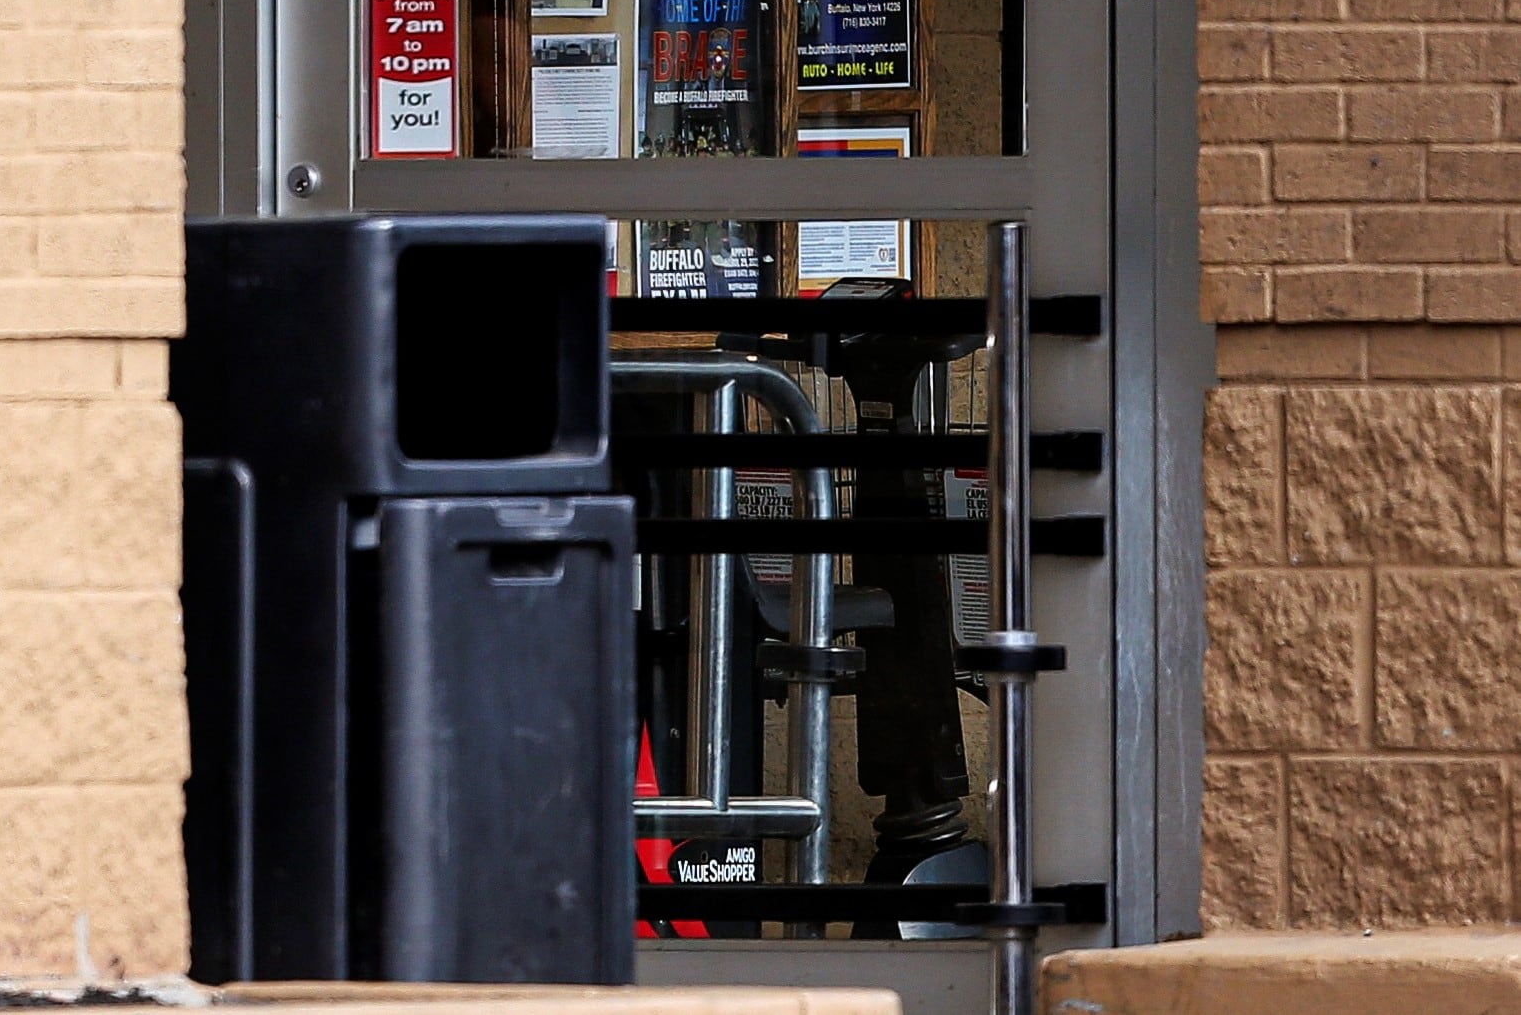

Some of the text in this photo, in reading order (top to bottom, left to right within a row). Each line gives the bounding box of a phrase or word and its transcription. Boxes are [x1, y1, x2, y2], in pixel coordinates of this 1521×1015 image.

[394, 0, 435, 12] from
[853, 4, 866, 13] New
[867, 2, 881, 13] York
[403, 39, 422, 52] to
[653, 29, 748, 82] BRAE
[803, 64, 828, 78] AUTO
[837, 62, 866, 76] HOME
[875, 61, 894, 75] LIFE
[399, 89, 431, 106] for
[654, 91, 678, 104] BECOME
[683, 90, 707, 102] BUFFALO
[391, 110, 439, 130] you!
[649, 248, 704, 271] BUFFALO
[649, 272, 706, 288] FIREFIGHTER
[739, 486, 777, 496] CAPACITY:
[767, 496, 780, 506] 227
[966, 499, 976, 509] EL
[744, 506, 759, 515] 125
[778, 506, 787, 515] 57
[967, 510, 976, 520] LA
[726, 847, 755, 863] AMIGO
